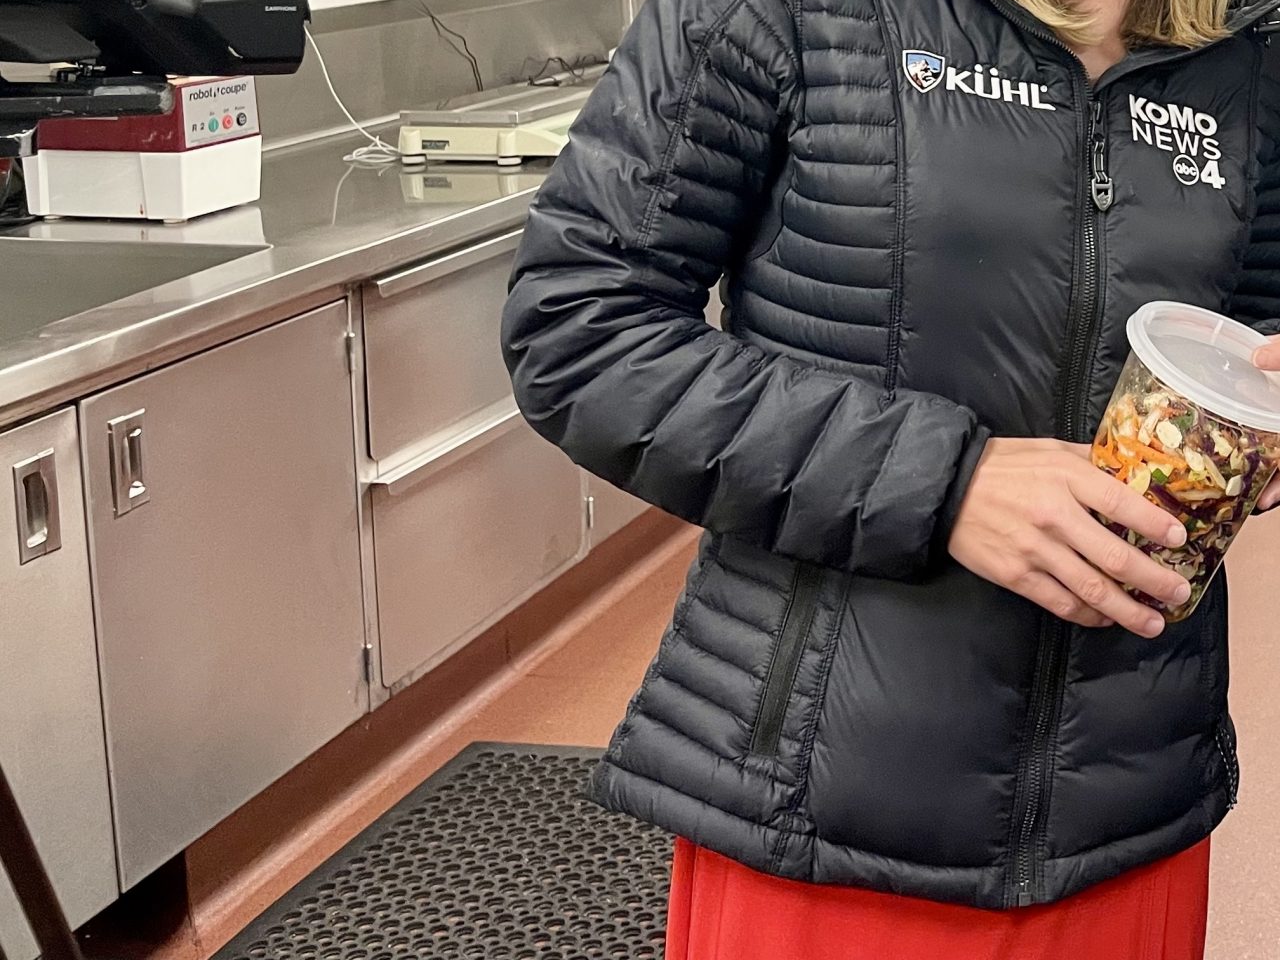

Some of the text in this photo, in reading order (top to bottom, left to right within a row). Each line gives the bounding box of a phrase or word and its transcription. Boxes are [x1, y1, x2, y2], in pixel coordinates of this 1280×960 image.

[189, 83, 246, 101] robot coupe
[1128, 93, 1217, 137] KOMO
[1131, 119, 1222, 161] NEWS
[1175, 160, 1226, 190] abc 4
